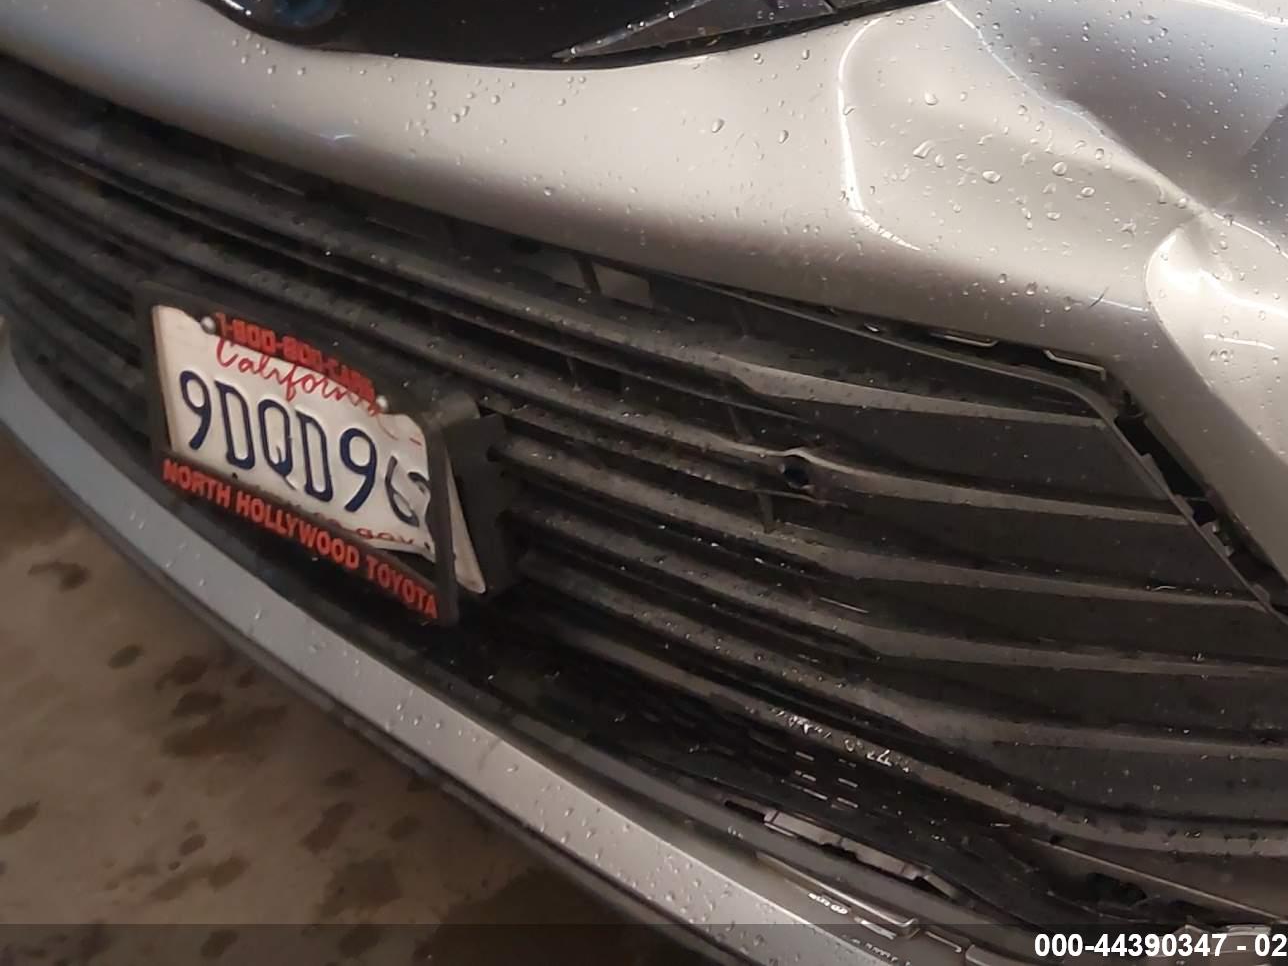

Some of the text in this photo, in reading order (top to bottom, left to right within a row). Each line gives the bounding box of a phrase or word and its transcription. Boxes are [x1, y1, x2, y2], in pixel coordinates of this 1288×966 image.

[163, 458, 231, 507] NORTH
[235, 486, 360, 571] HOLLYWOOD
[366, 554, 439, 620] TOYOTA
